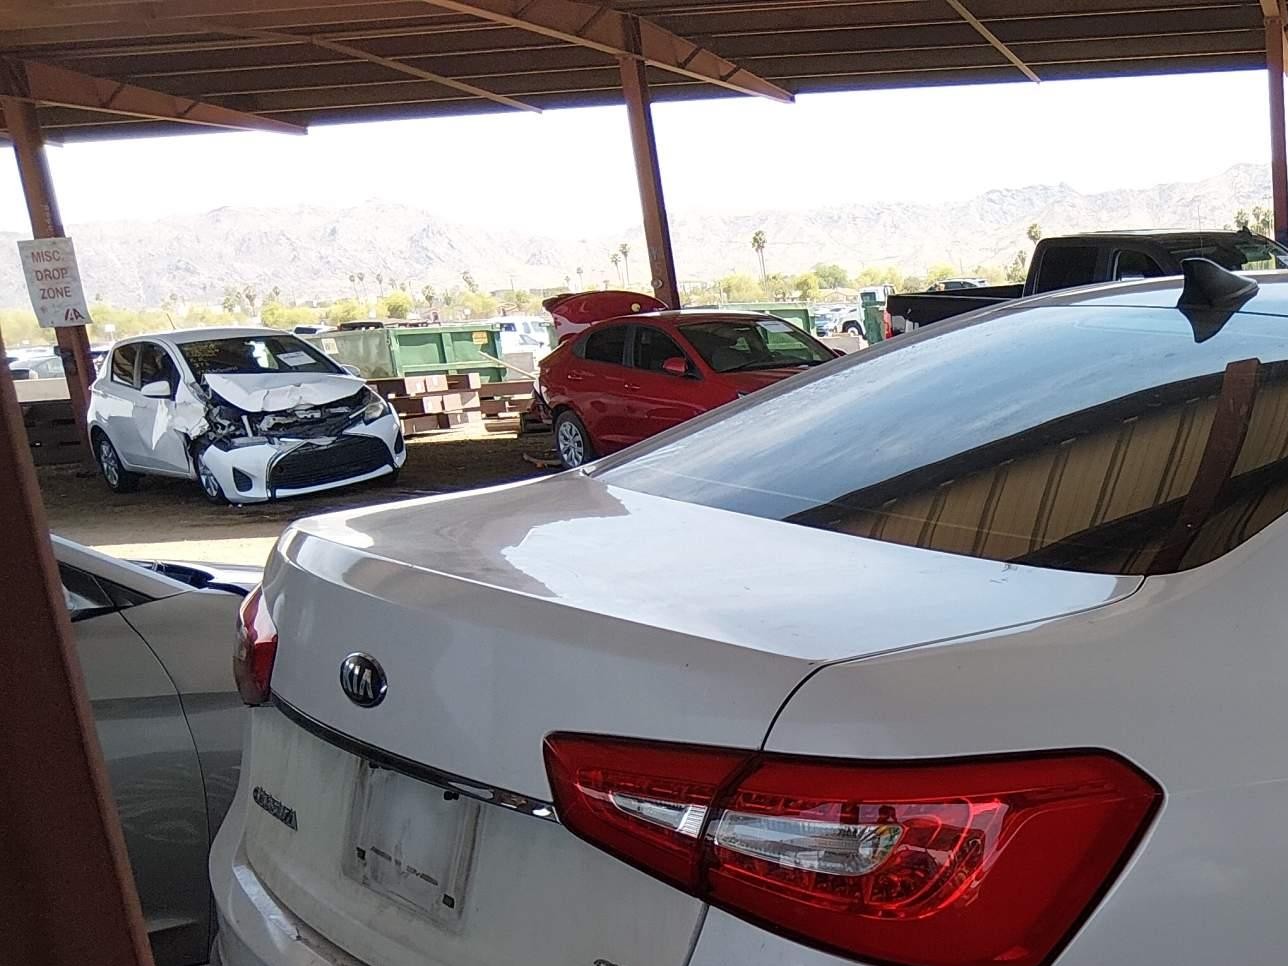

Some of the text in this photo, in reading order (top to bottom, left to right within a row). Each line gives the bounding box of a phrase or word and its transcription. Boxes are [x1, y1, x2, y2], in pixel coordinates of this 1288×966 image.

[31, 249, 65, 263] MISC.
[35, 266, 69, 282] DROP
[40, 286, 72, 300] ZONE
